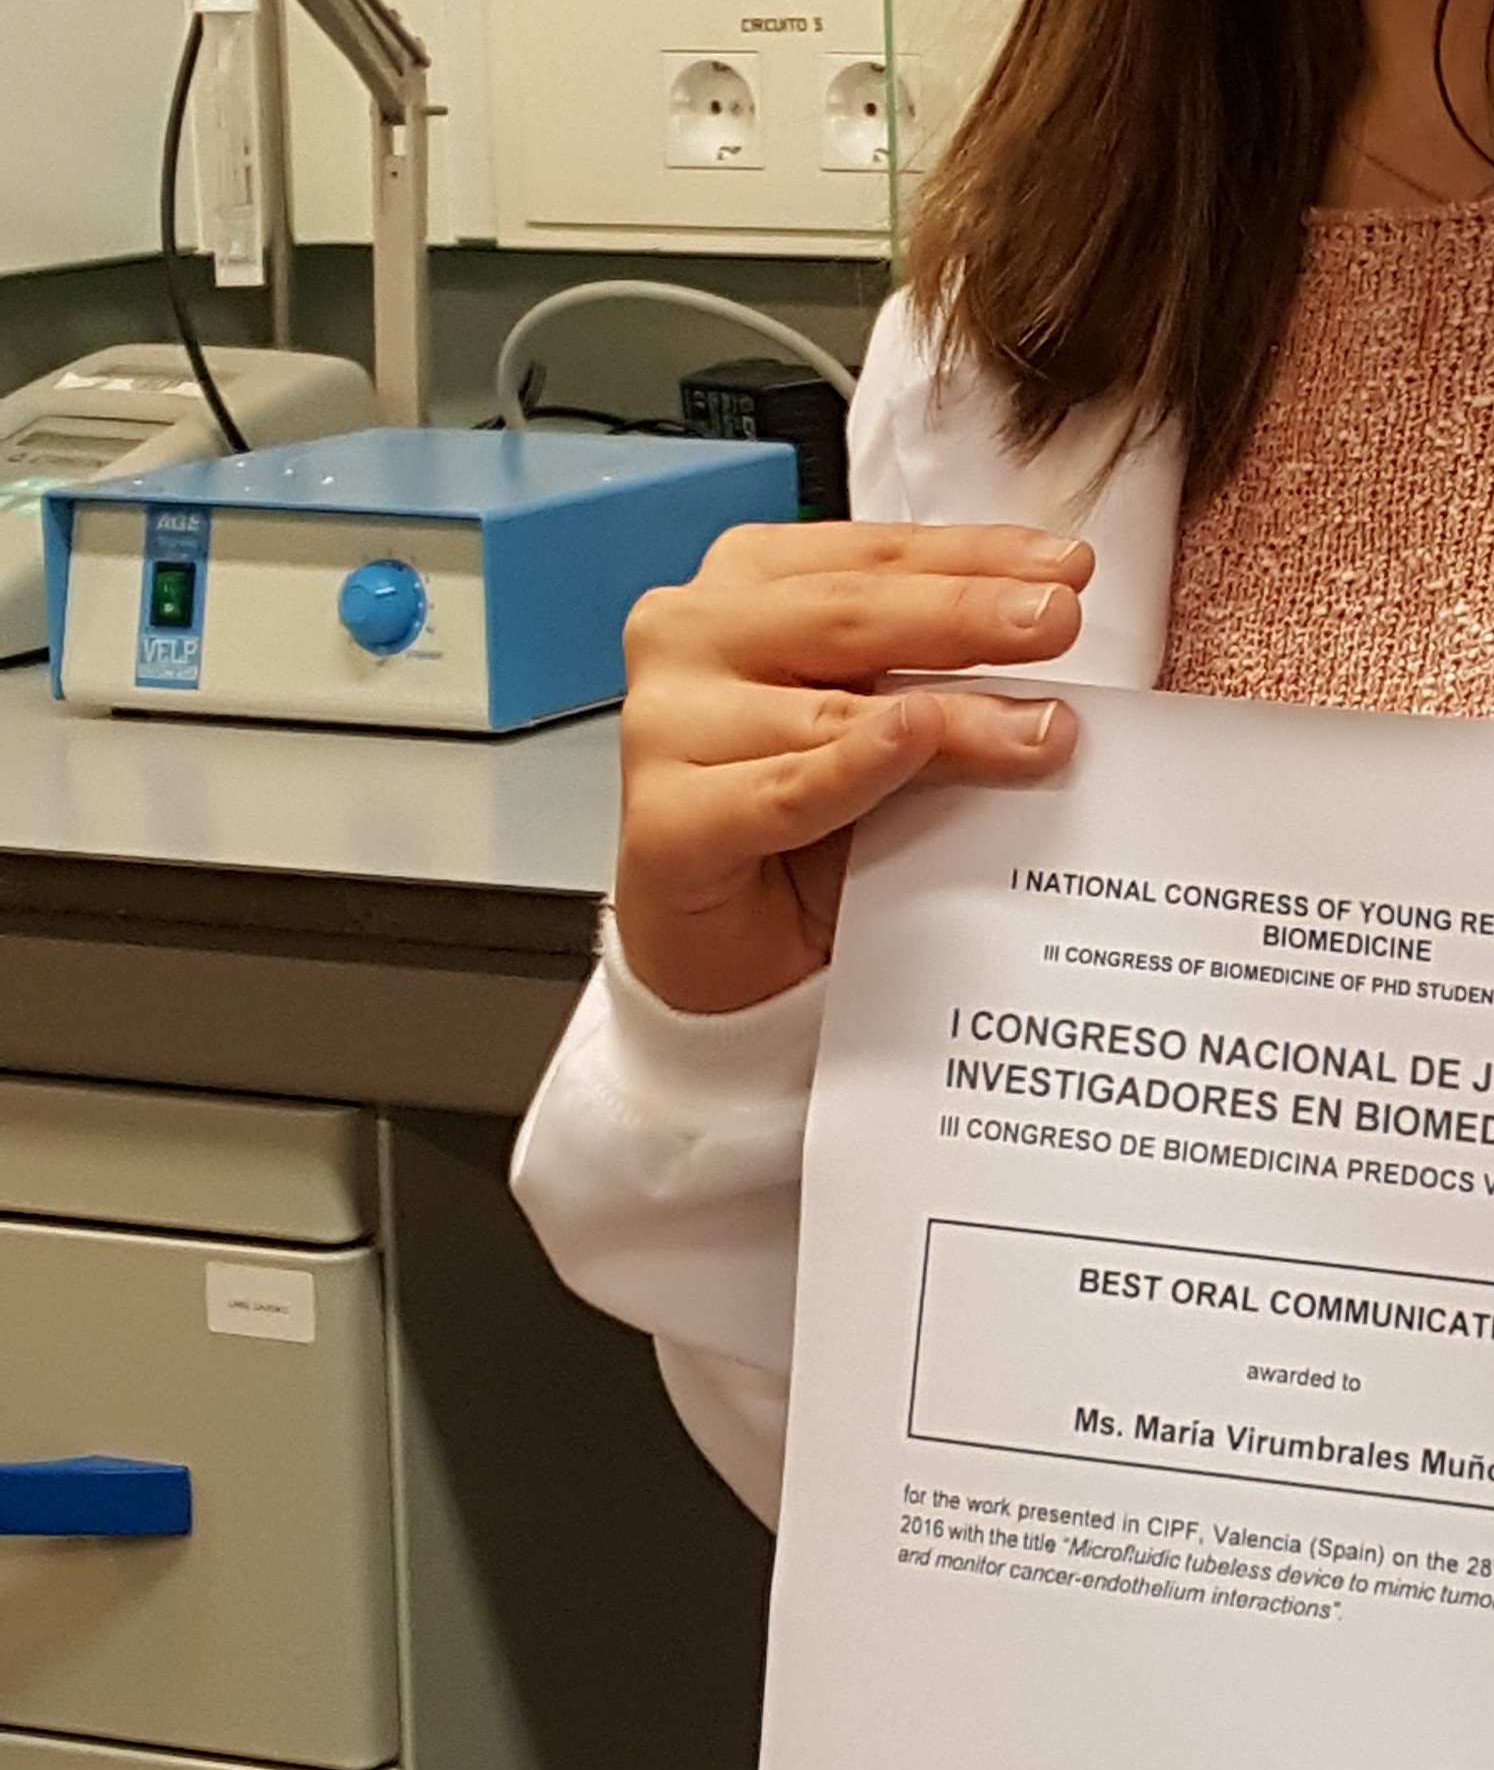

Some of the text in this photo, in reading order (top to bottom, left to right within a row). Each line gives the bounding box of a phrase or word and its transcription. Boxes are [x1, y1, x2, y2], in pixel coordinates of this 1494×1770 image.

[741, 17, 807, 33] CIRCUITO
[1010, 868, 1018, 890] I
[1025, 869, 1156, 903] NATIONAL
[1164, 883, 1308, 917] CONGRESS
[1316, 897, 1351, 921] OF
[1359, 900, 1452, 931] YOUNG
[1043, 944, 1060, 961] III
[1064, 946, 1173, 973] CONGRESS
[1177, 957, 1206, 975] OF
[1209, 960, 1335, 989] BIOMEDICINE
[1339, 973, 1366, 992] OF
[1371, 976, 1411, 996] PHD
[1262, 924, 1432, 962] BIOMEDICINE
[951, 1007, 959, 1038] I
[970, 1010, 1186, 1060] CONGRESO
[1198, 1032, 1397, 1083] NACIONAL
[1409, 1054, 1461, 1090] DE
[945, 1057, 1278, 1121] INVESTIGADORES
[1291, 1093, 1342, 1128] EN
[939, 1114, 959, 1137] III
[966, 1117, 1112, 1153] CONGRESO
[1119, 1133, 1156, 1158] DE
[1162, 1138, 1338, 1178] BIOMEDICINA
[1346, 1158, 1474, 1193] PREDOCS
[1078, 1267, 1163, 1300] BEST
[1170, 1277, 1259, 1312] ORAL
[1246, 1364, 1361, 1392] awarded to
[1074, 1406, 1123, 1437] Ms.
[1134, 1413, 1215, 1447] María
[1226, 1424, 1409, 1471] Virumbrales
[899, 1513, 944, 1538] 2016
[947, 1523, 984, 1544] with
[988, 1527, 1018, 1549] the
[1022, 1531, 1056, 1554] title
[1184, 1552, 1272, 1581] tubeless
[1275, 1563, 1345, 1590] device
[1348, 1572, 1369, 1593] to
[1373, 1577, 1436, 1602] mimic
[903, 1482, 927, 1504] for
[932, 1489, 960, 1510] the
[966, 1497, 1011, 1516] work
[1017, 1503, 1116, 1530] presented
[1121, 1514, 1139, 1534] in
[1212, 1523, 1301, 1554] Valencia
[1309, 1536, 1384, 1567] (Spain)
[1391, 1551, 1418, 1568] on
[1426, 1550, 1459, 1574] the
[897, 1547, 932, 1566] and
[934, 1553, 1007, 1576] monitor
[1008, 1563, 1206, 1603] cancer-endothelium
